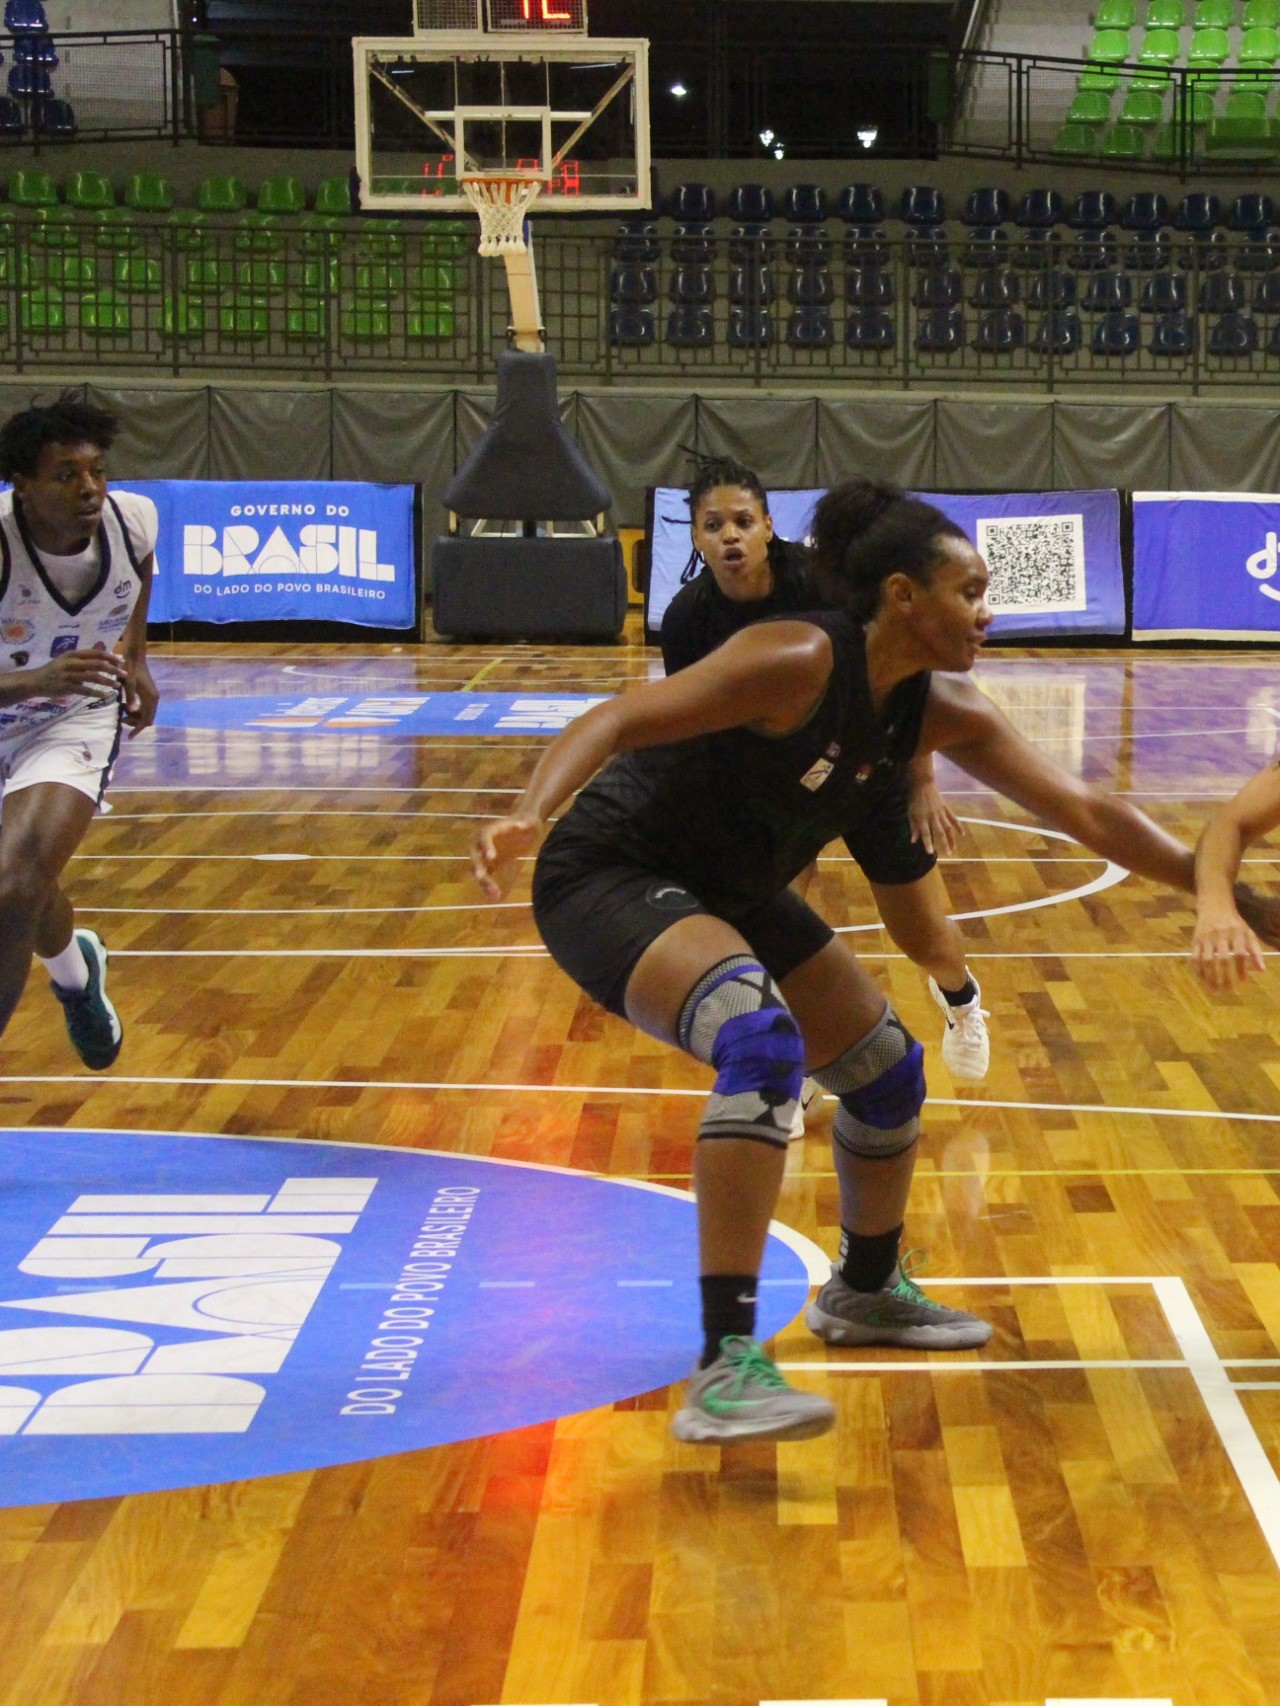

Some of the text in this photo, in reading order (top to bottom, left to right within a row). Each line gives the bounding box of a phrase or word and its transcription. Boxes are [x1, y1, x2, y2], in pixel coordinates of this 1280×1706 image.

[230, 504, 350, 517] GOVERNO DO
[183, 524, 396, 582] BRASIL
[193, 582, 386, 600] DO LADO DO POVO BRASILEIRO
[340, 1186, 481, 1415] DO LADO DO POVO BRASILEIRO
